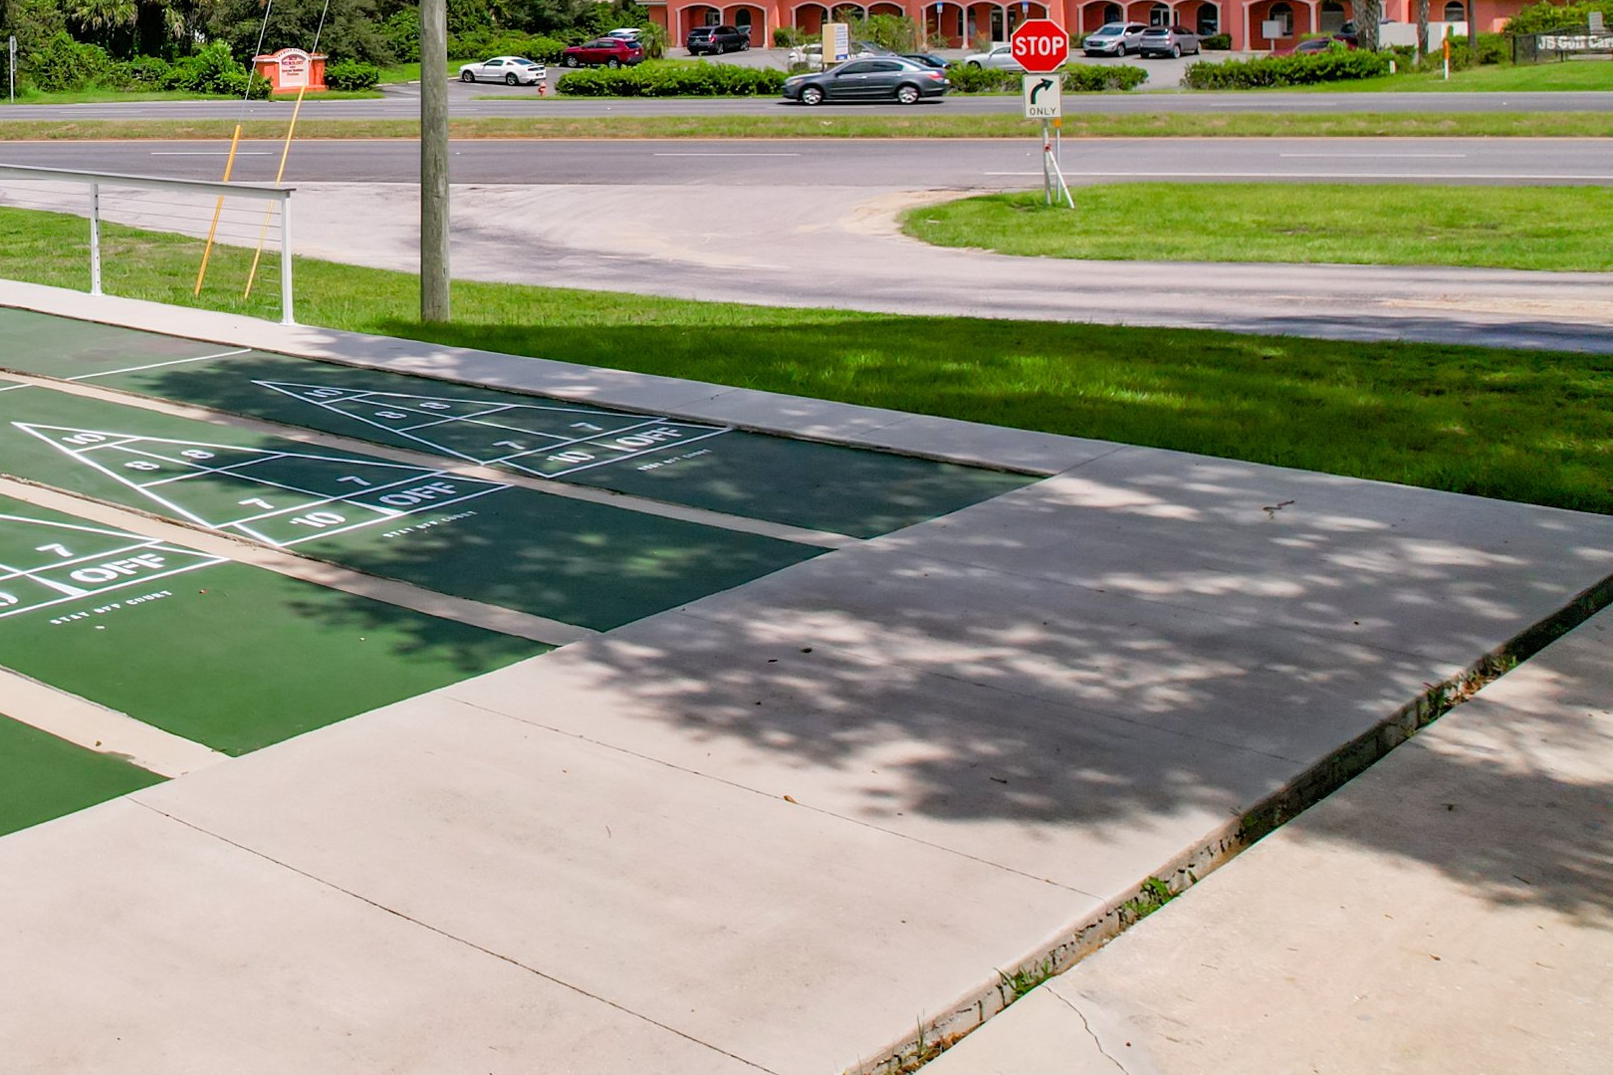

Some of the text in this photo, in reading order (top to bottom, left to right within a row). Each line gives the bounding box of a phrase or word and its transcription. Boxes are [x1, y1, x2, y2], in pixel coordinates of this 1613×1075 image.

[1015, 36, 1065, 56] STOP
[1029, 107, 1057, 116] ONLY
[304, 388, 344, 398] 10
[419, 402, 451, 410] 8
[374, 411, 407, 419] 8
[569, 422, 603, 431] 7
[61, 432, 107, 445] 10
[492, 440, 526, 450] 7
[547, 426, 683, 464] 10 OFF
[181, 449, 215, 460] 8
[124, 461, 160, 471] 8
[336, 475, 372, 486] 7
[238, 497, 275, 509] 7
[289, 481, 457, 528] 10 OFF
[35, 543, 74, 558] 7
[70, 553, 166, 583] OFF
